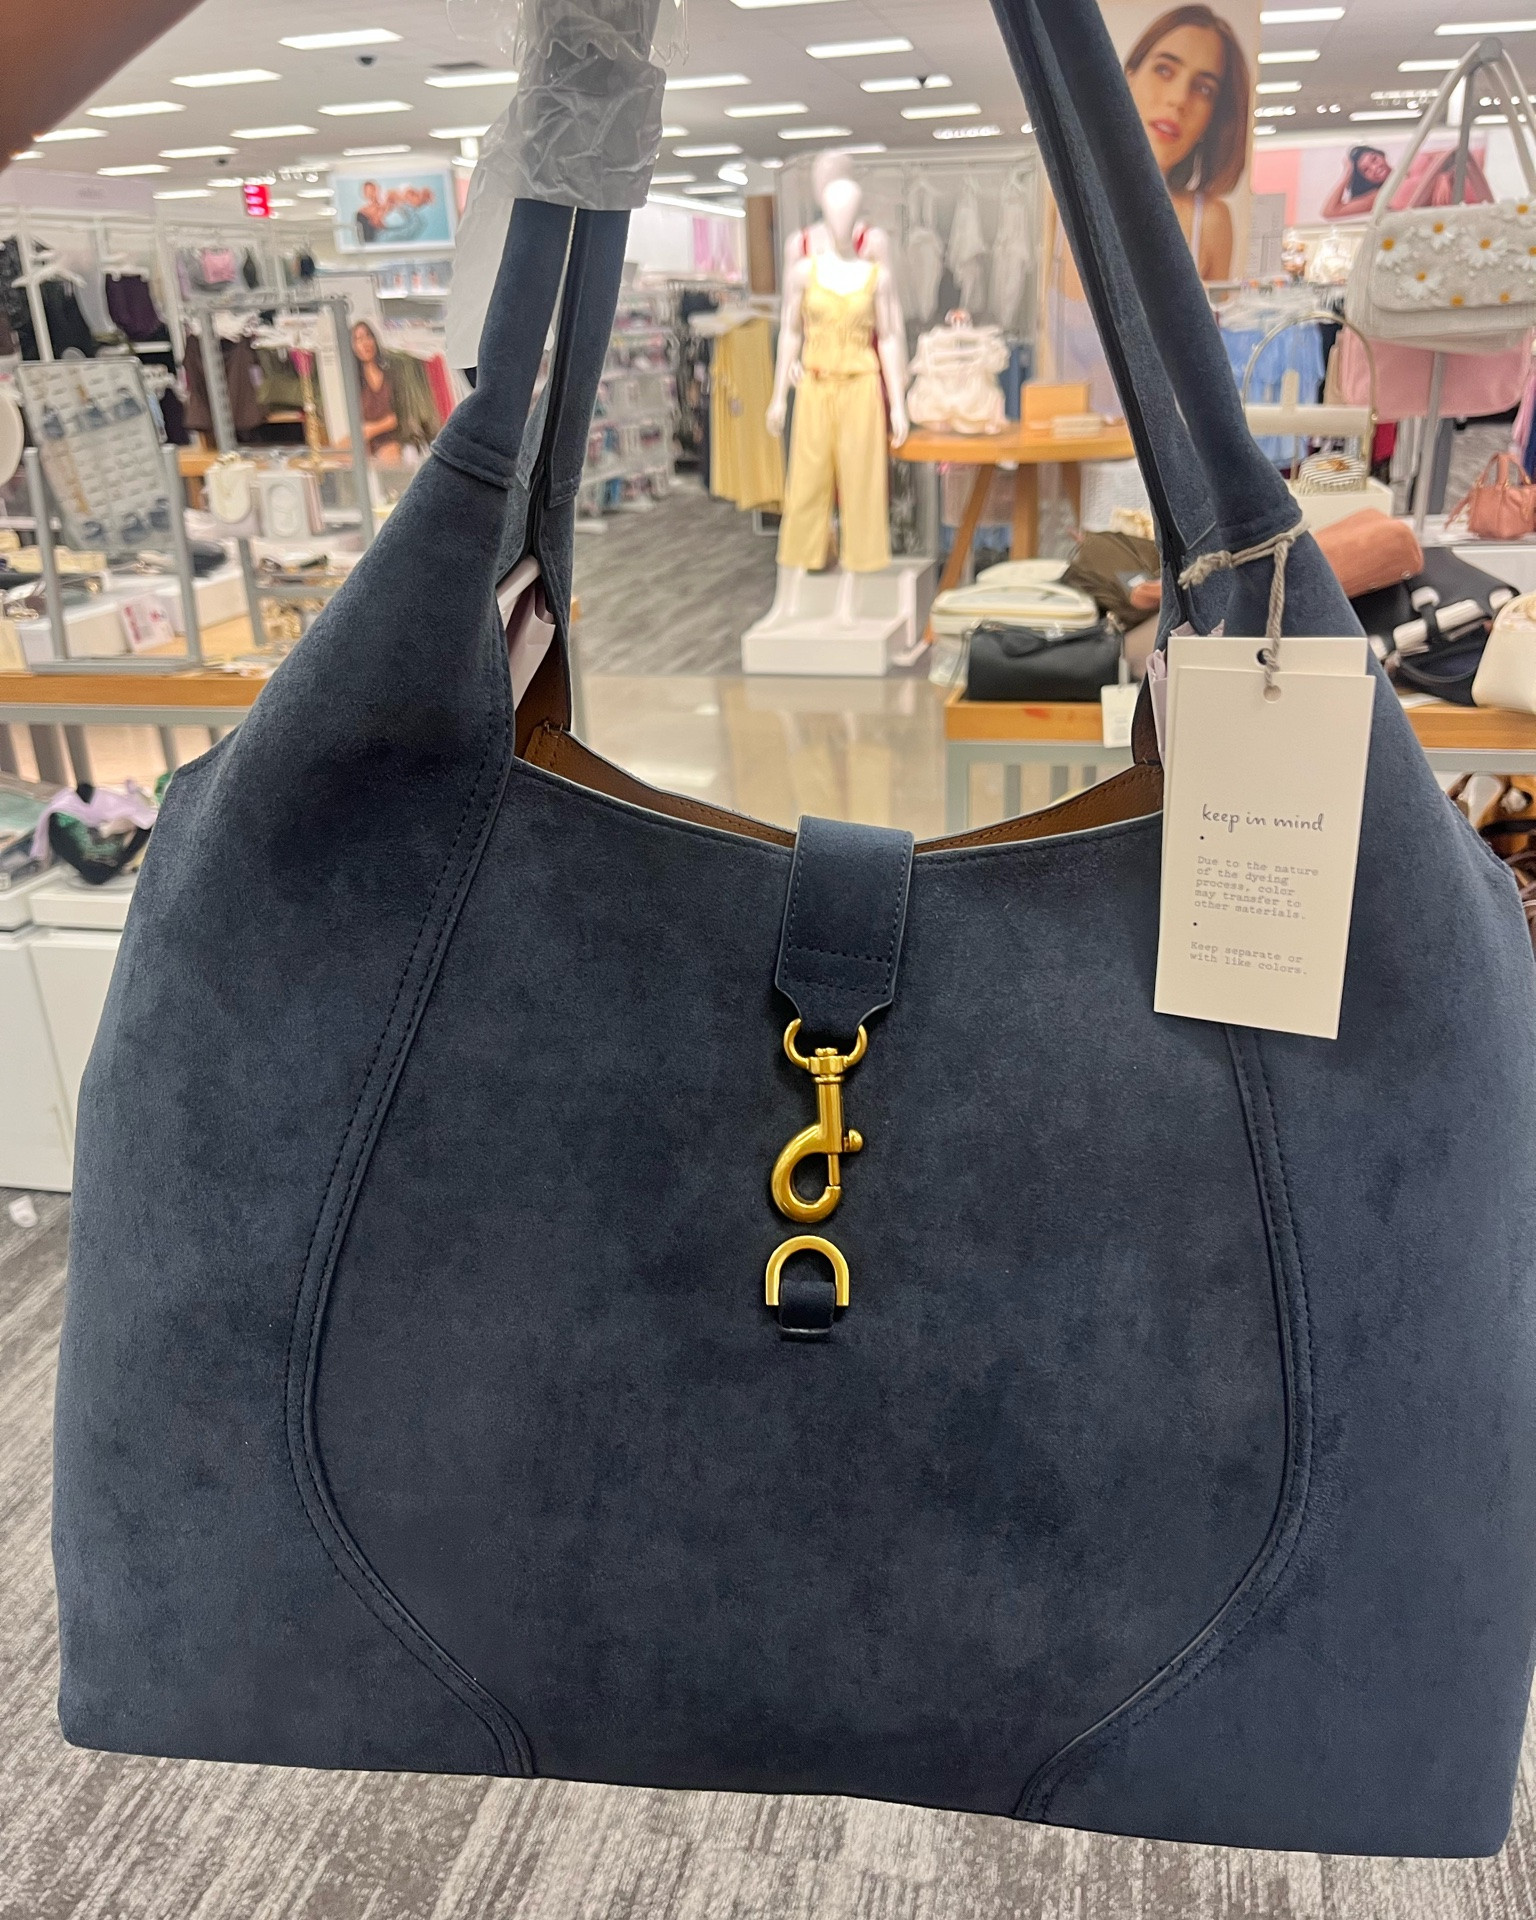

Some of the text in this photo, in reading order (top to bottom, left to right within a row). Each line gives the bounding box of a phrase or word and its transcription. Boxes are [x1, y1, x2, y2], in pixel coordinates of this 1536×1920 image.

[1202, 803, 1324, 833] keep in mind
[1197, 855, 1319, 876] Due to the nature
[1196, 867, 1289, 886] of the dyeing
[1194, 889, 1301, 908] may transfer to
[1258, 885, 1295, 897] color
[1194, 899, 1306, 920] other materials.
[1190, 941, 1303, 964] Keep separate or
[1190, 952, 1307, 975] with like colors.
